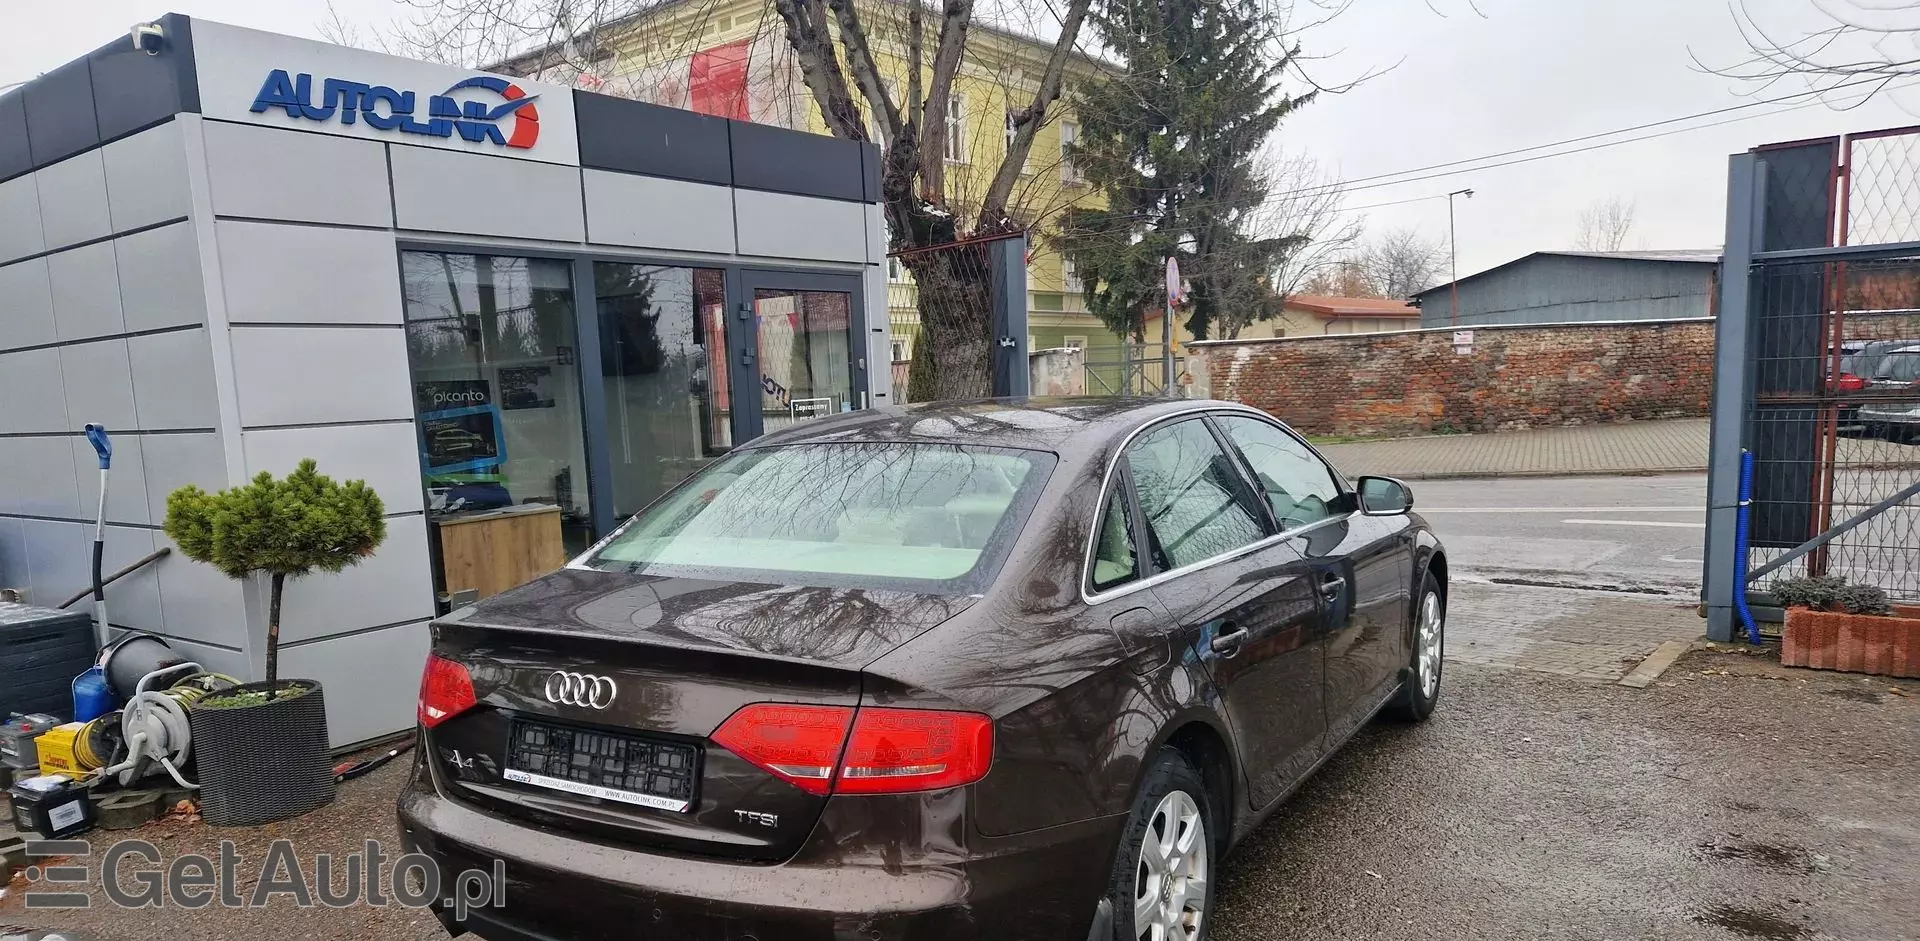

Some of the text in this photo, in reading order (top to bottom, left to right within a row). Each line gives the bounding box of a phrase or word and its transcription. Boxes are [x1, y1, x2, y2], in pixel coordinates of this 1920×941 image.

[249, 69, 507, 146] AUTOLINK
[433, 389, 484, 405] picanto
[449, 749, 473, 768] A4
[734, 809, 778, 828] TFSI
